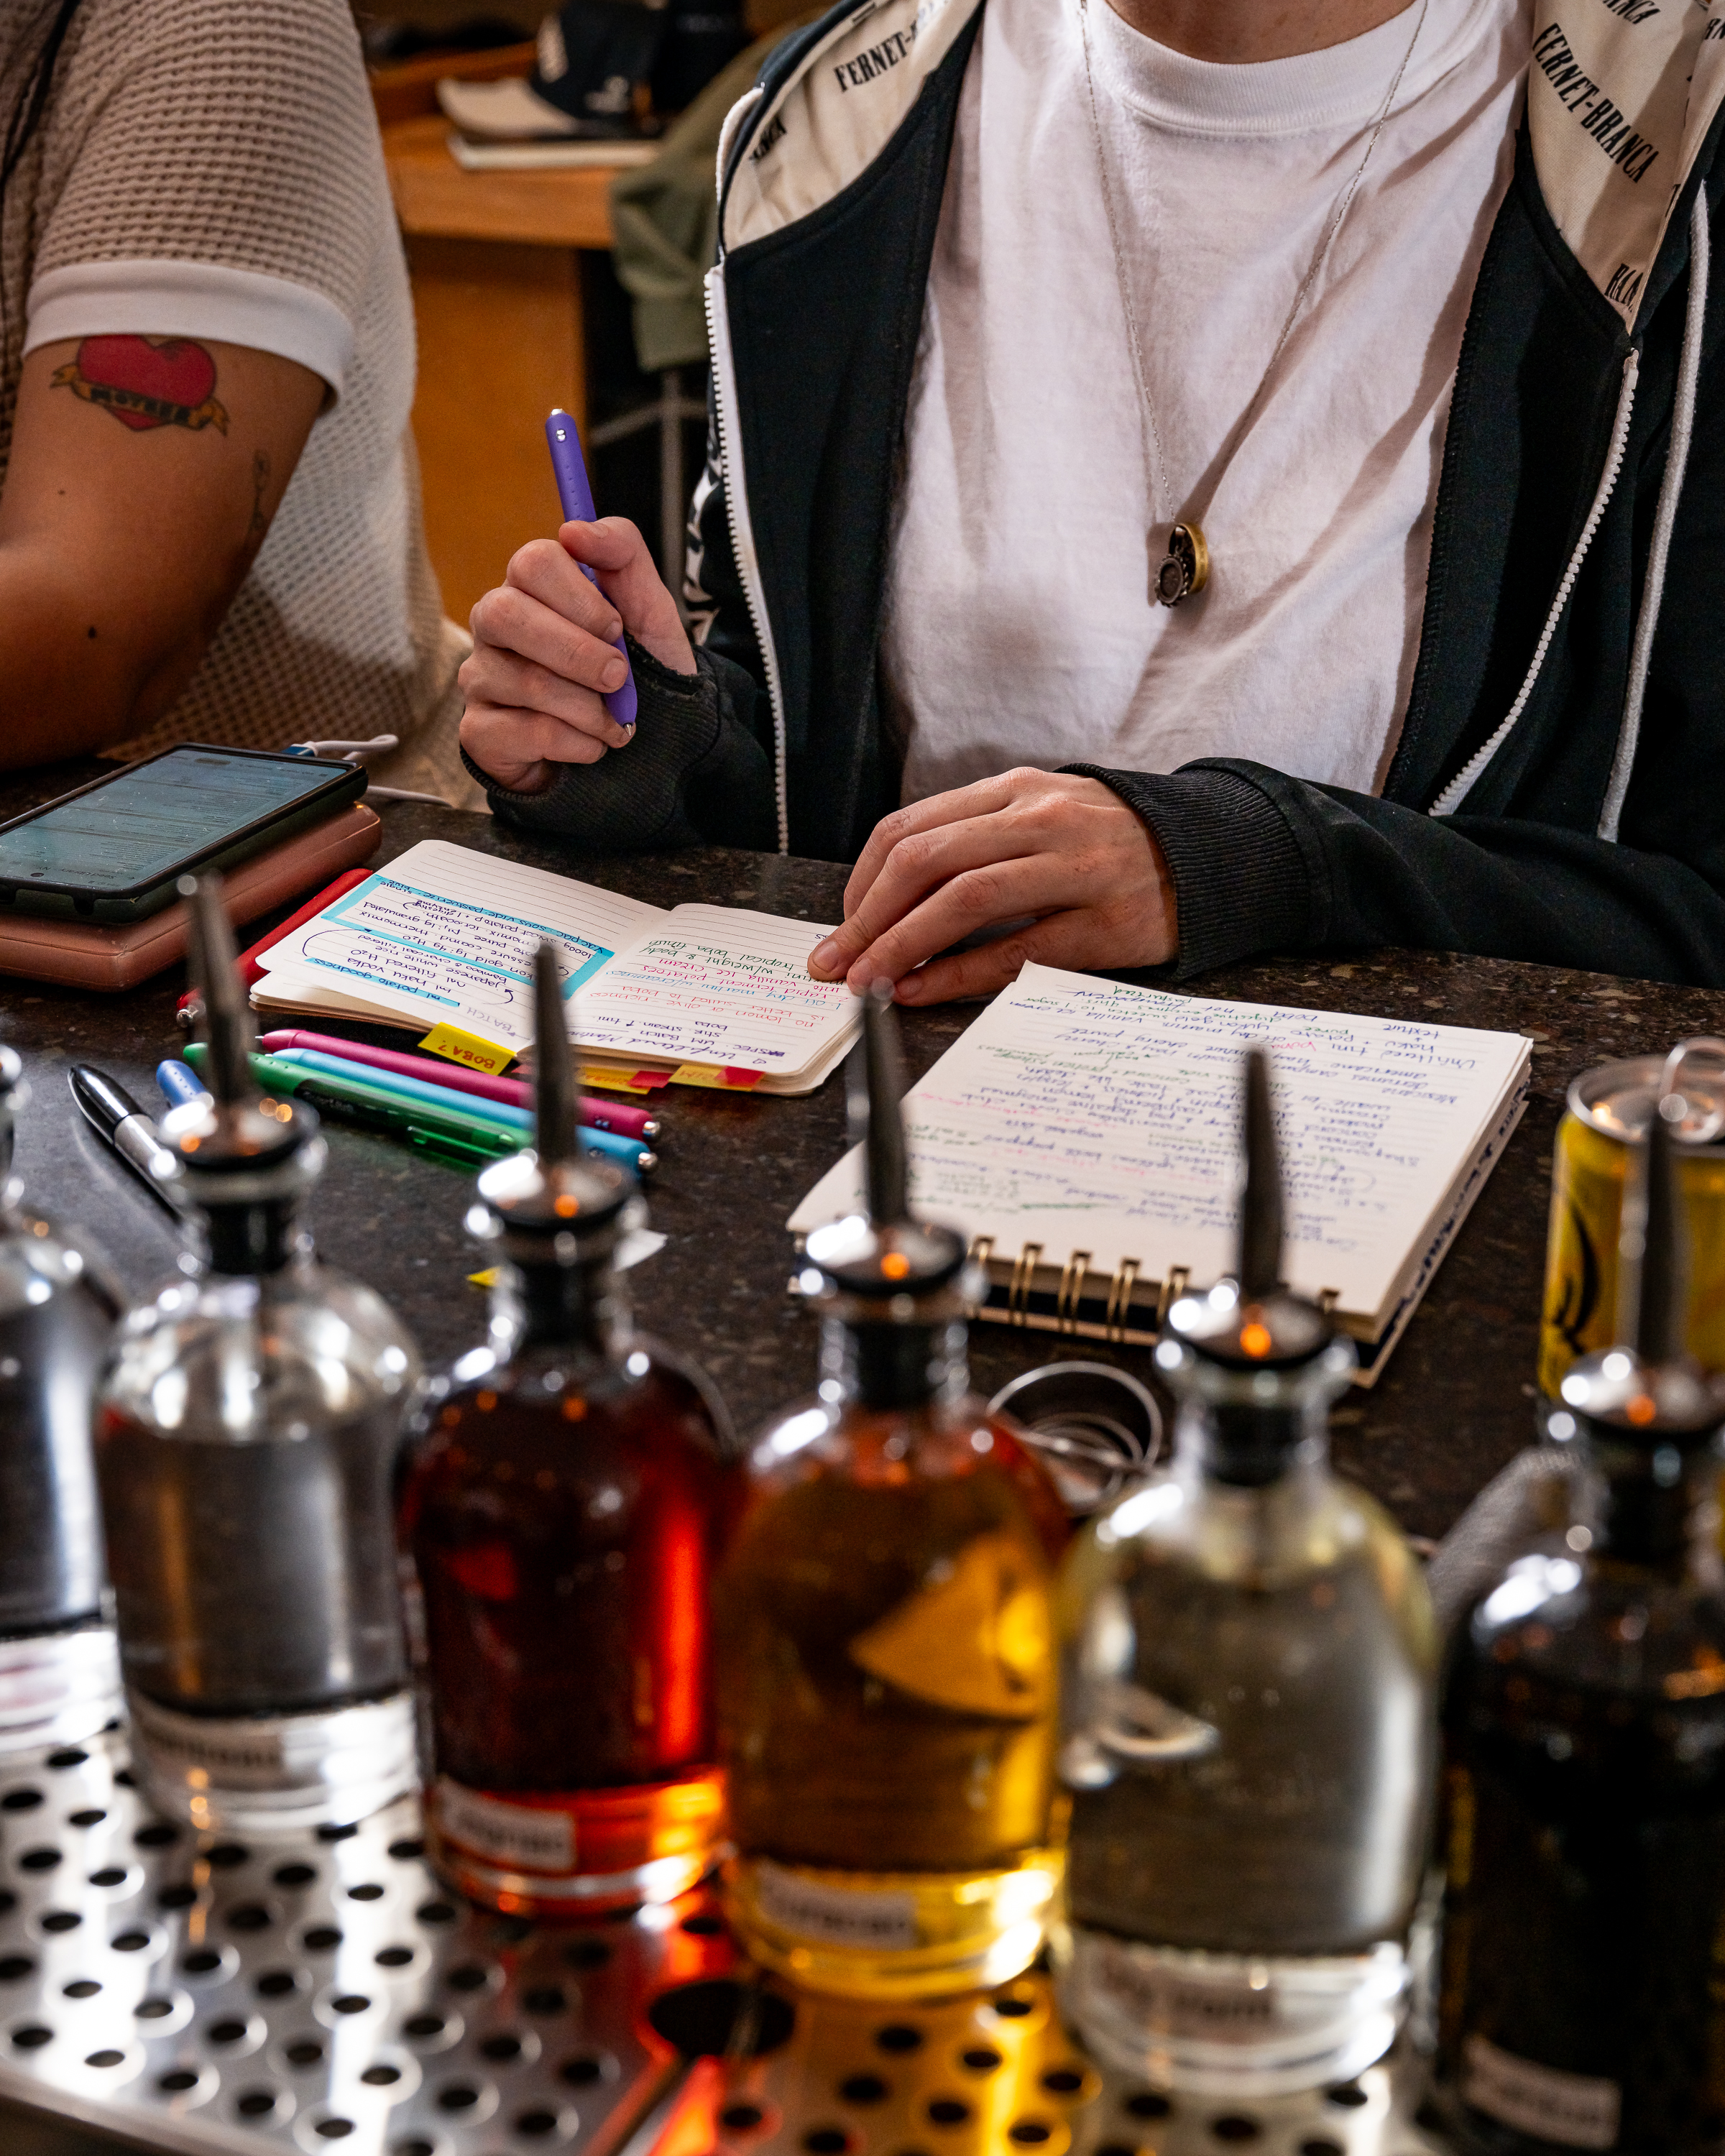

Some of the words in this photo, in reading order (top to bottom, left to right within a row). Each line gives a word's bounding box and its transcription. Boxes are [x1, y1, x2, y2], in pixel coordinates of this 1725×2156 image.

[834, 20, 918, 93] FERNET-
[1532, 22, 1660, 183] FERNET-BRANCA
[363, 901, 420, 923] granulated
[359, 912, 428, 936] thermomix
[520, 920, 546, 931] sous
[374, 946, 398, 957] rice
[638, 946, 678, 957] body
[697, 945, 728, 958] boba
[347, 957, 384, 973] vodka
[404, 954, 438, 968] white
[474, 955, 503, 968] gold
[658, 959, 704, 972] cream
[740, 954, 794, 972] tropical
[313, 958, 372, 980] goodness
[386, 959, 436, 979] filtered
[466, 965, 507, 985] bamboo
[640, 964, 707, 982] potatoes
[717, 969, 736, 978] ice
[392, 971, 426, 986] haku
[445, 967, 501, 990] japanese
[718, 978, 775, 992] ferment
[748, 975, 796, 987] vanilla
[379, 978, 418, 993] potato
[622, 985, 659, 998] boba
[700, 983, 755, 996] martini
[812, 985, 840, 994] into
[765, 990, 795, 1003] dry
[784, 987, 827, 1000] rapid
[666, 1000, 701, 1010] olive
[747, 1005, 792, 1018] better
[466, 1006, 512, 1032] BATCH
[735, 1010, 782, 1024] lemon
[794, 1019, 814, 1028] no
[1085, 1011, 1143, 1024] vanilla
[640, 1030, 680, 1041] Batch
[1230, 1028, 1258, 1039] dry
[1289, 1030, 1353, 1043] potato
[1381, 1023, 1439, 1039] texture
[625, 1037, 736, 1061] Unfiltered
[1384, 1041, 1435, 1054] haku
[1379, 1049, 1476, 1070] Unfiltered
